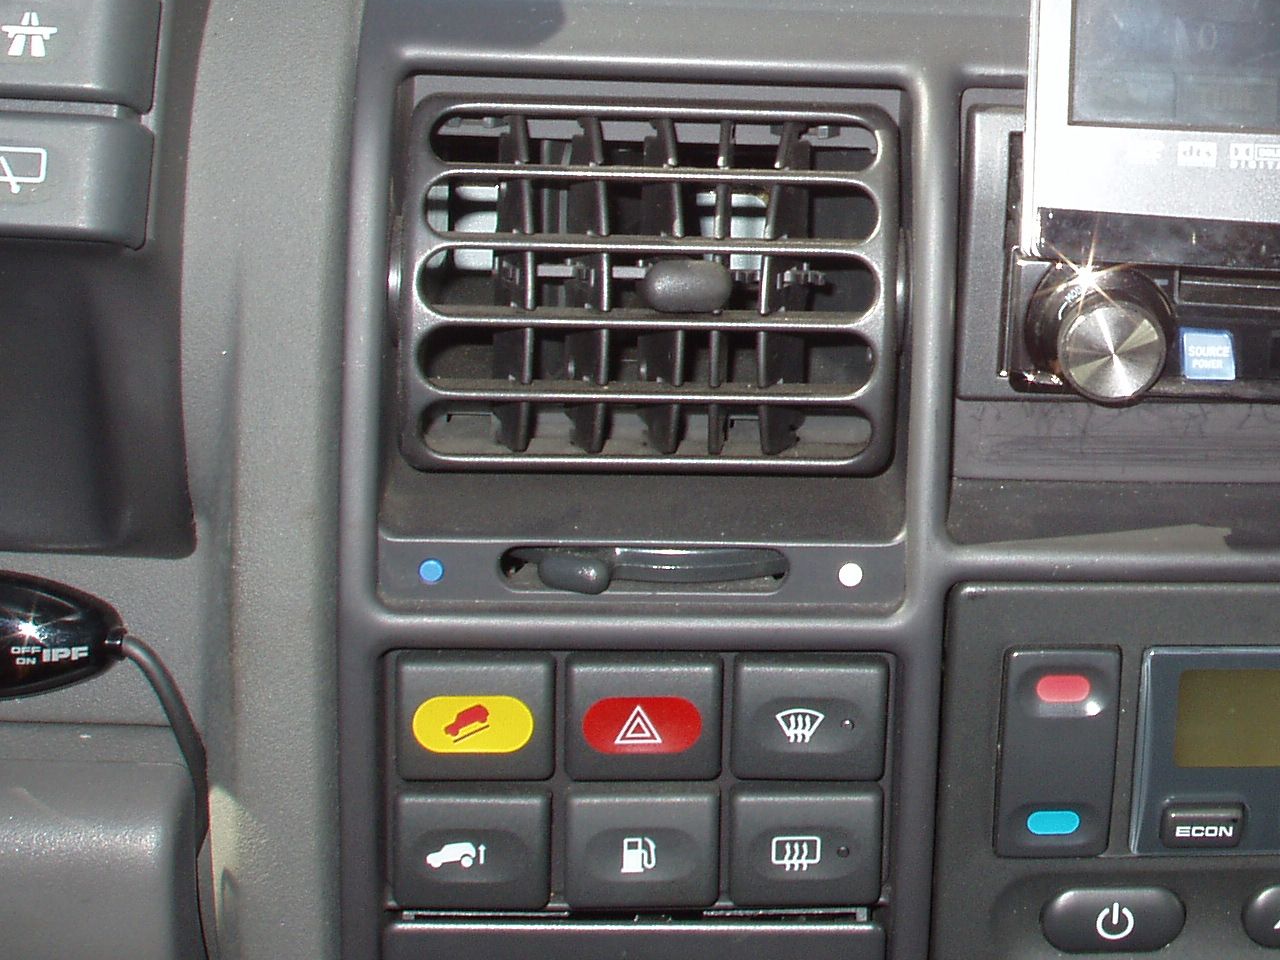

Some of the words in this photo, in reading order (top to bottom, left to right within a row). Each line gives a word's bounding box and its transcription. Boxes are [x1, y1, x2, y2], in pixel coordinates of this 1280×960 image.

[1188, 344, 1230, 356] SOURCE
[1191, 359, 1224, 370] POWER
[10, 646, 42, 655] OFF
[42, 645, 89, 663] IPF
[15, 657, 37, 666] ON
[1175, 825, 1234, 838] ECON
